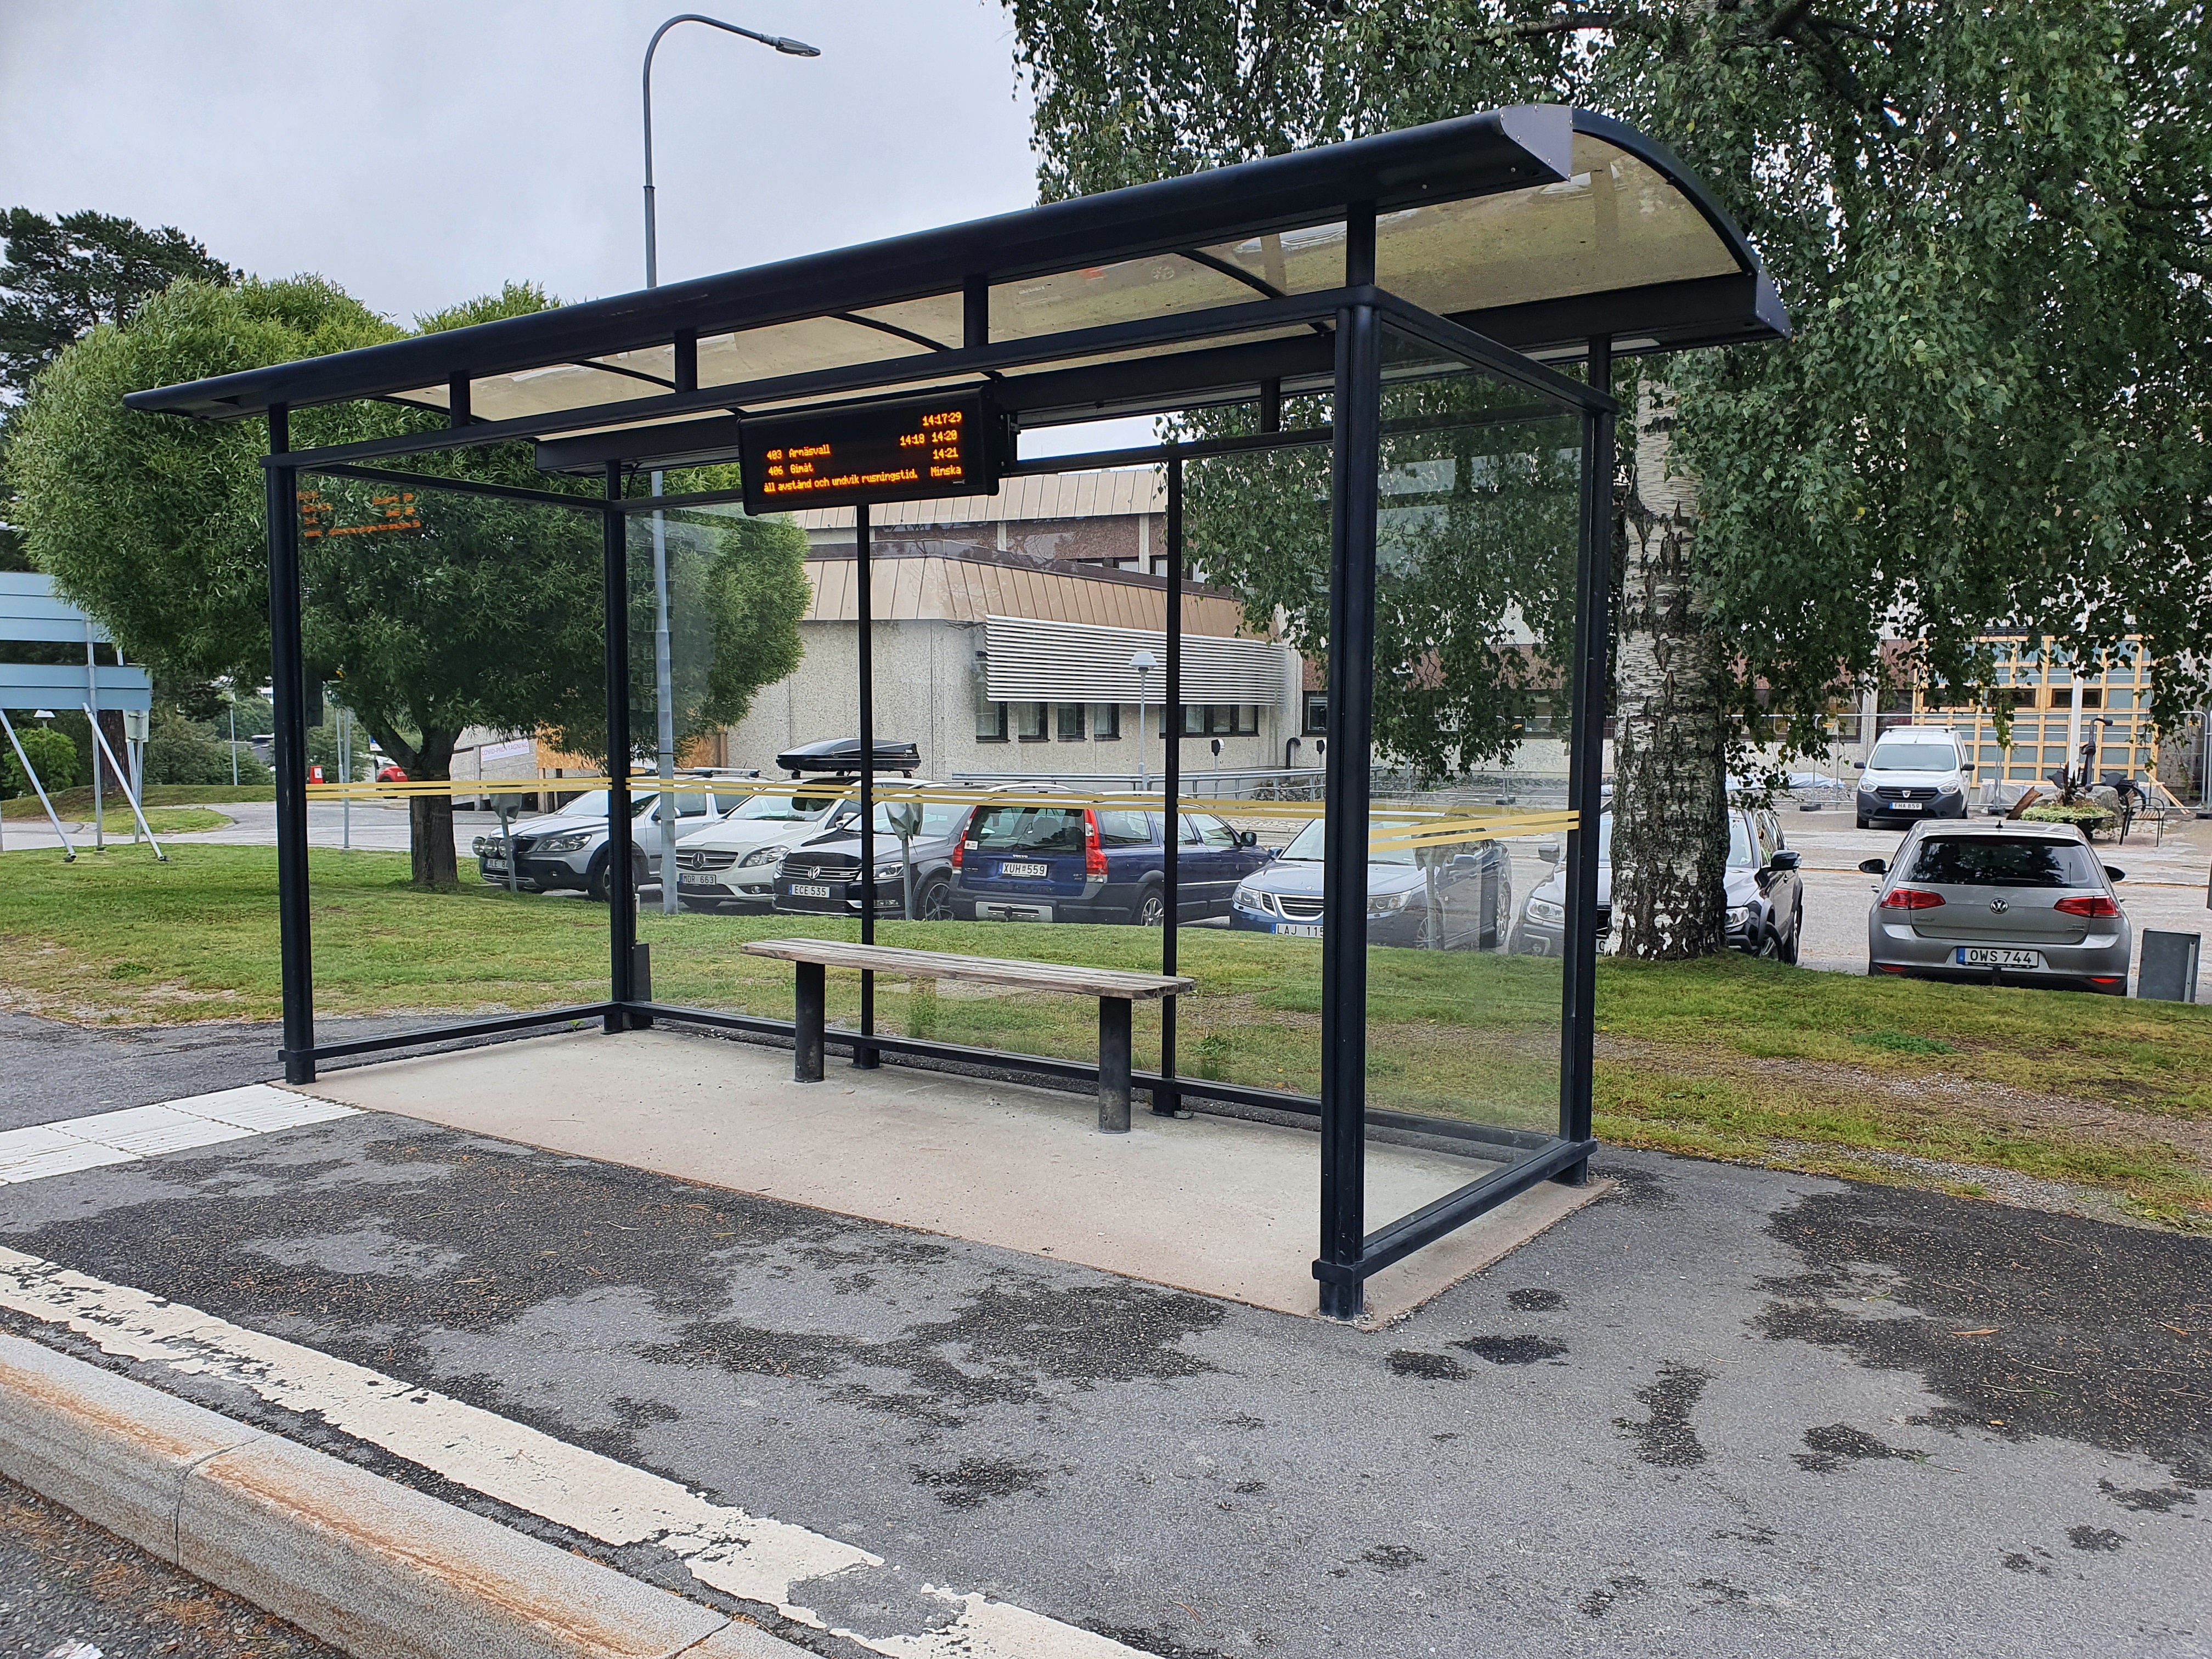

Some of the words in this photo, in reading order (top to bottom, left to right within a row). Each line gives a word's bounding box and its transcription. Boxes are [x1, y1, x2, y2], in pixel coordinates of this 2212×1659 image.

[922, 411, 962, 426] 14:17:29
[767, 449, 782, 460] 403
[789, 444, 831, 458] Arnäsvall
[900, 433, 925, 446] 14:18
[932, 430, 957, 442] 14:20
[768, 465, 784, 476] 406
[790, 462, 814, 474] Gimåt
[933, 447, 958, 459] 14:21
[777, 478, 812, 491] avstånd
[814, 477, 830, 488] och
[832, 474, 860, 486] undvik
[861, 469, 918, 484] rusningstid.
[930, 465, 962, 477] Minska
[1003, 864, 1020, 874] XUH
[1027, 865, 1045, 874] 559
[794, 885, 809, 895] ECE
[811, 887, 826, 896] 535
[1277, 924, 1297, 935] LAJ
[1970, 950, 1997, 962] OWS
[2004, 951, 2032, 963] 744
